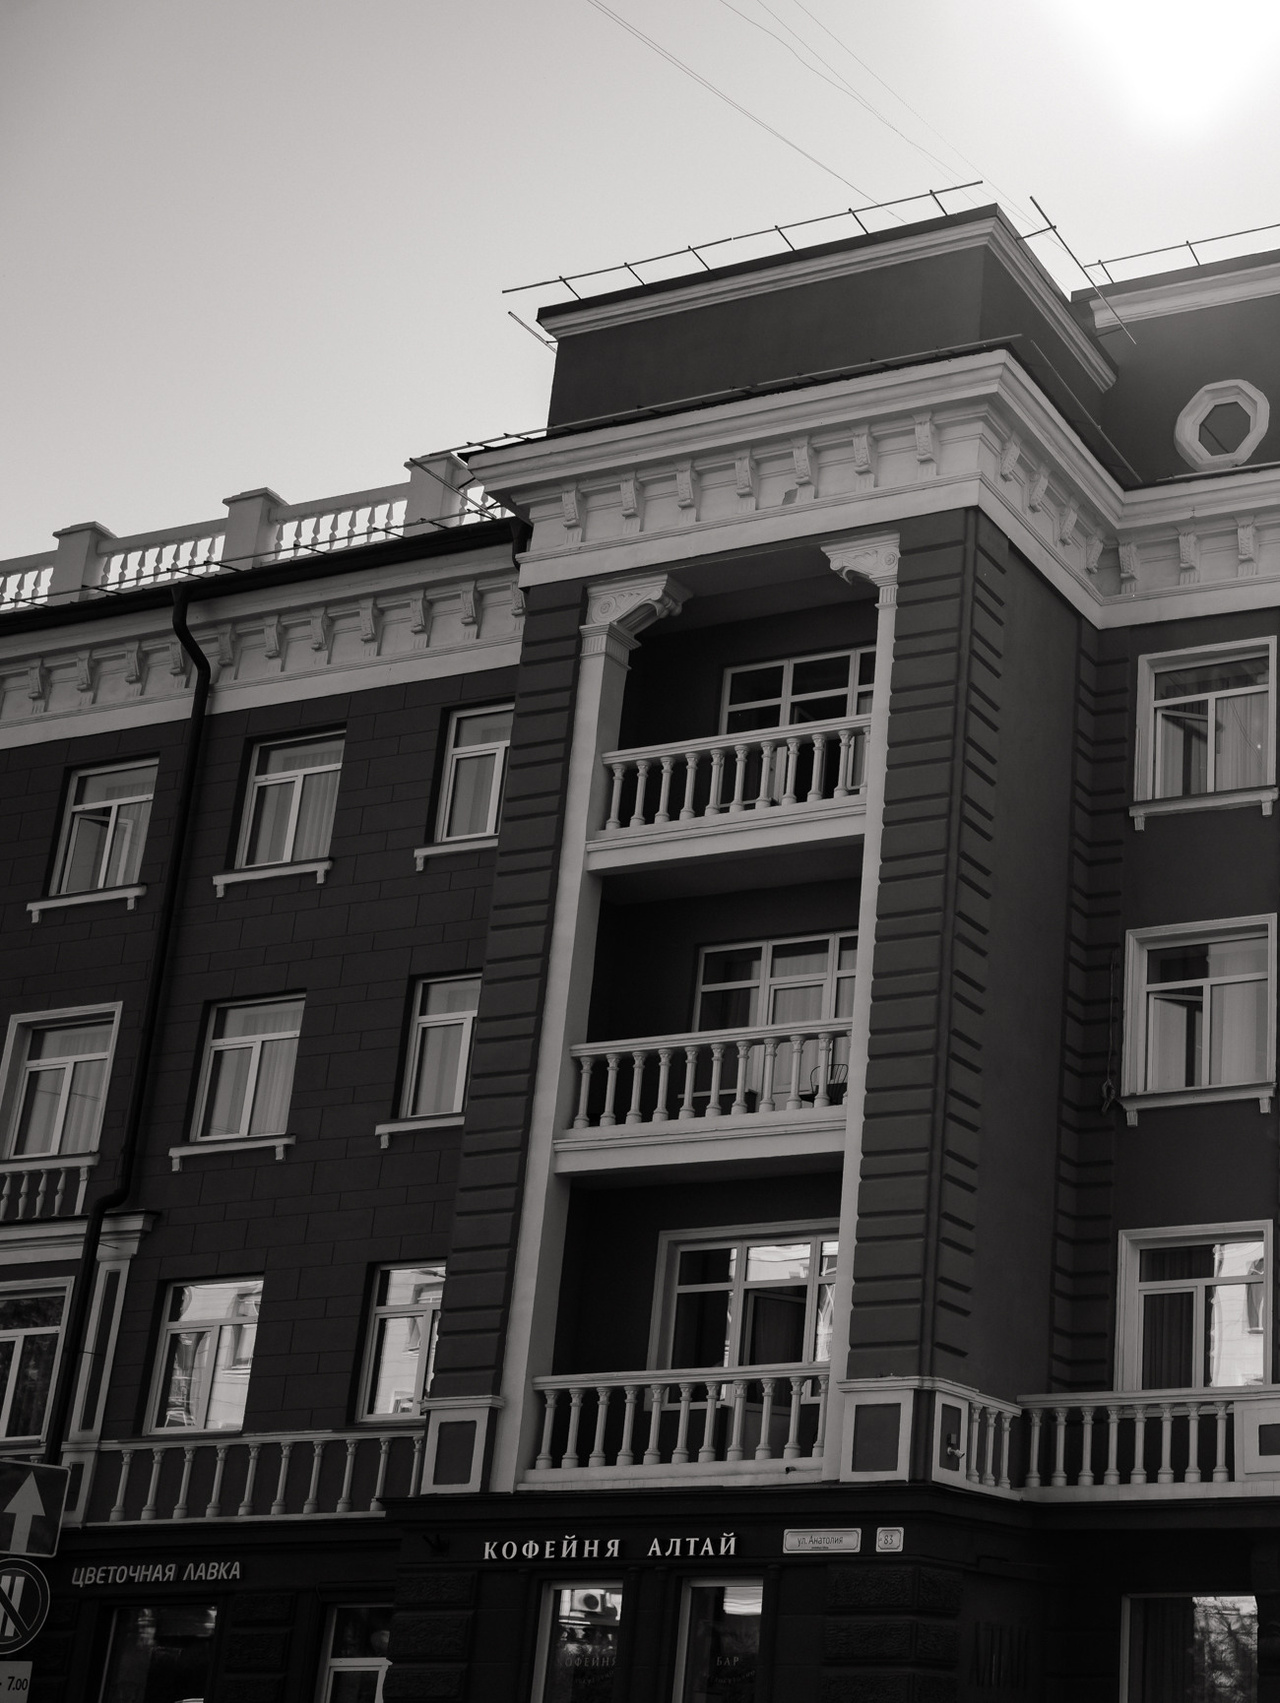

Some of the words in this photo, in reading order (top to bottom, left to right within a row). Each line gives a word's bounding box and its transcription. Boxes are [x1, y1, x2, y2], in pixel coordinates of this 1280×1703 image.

[808, 1535, 844, 1546] Анатолия
[883, 1534, 894, 1545] 83
[483, 1534, 621, 1561] КОФЕЙНЯ
[647, 1532, 738, 1558] АЛТАЙ
[71, 1563, 177, 1588] ЦВЕТОЧНАЯ
[182, 1561, 242, 1581] ЛАВКА
[716, 1656, 740, 1667] БАР
[7, 1676, 28, 1691] 7.00
